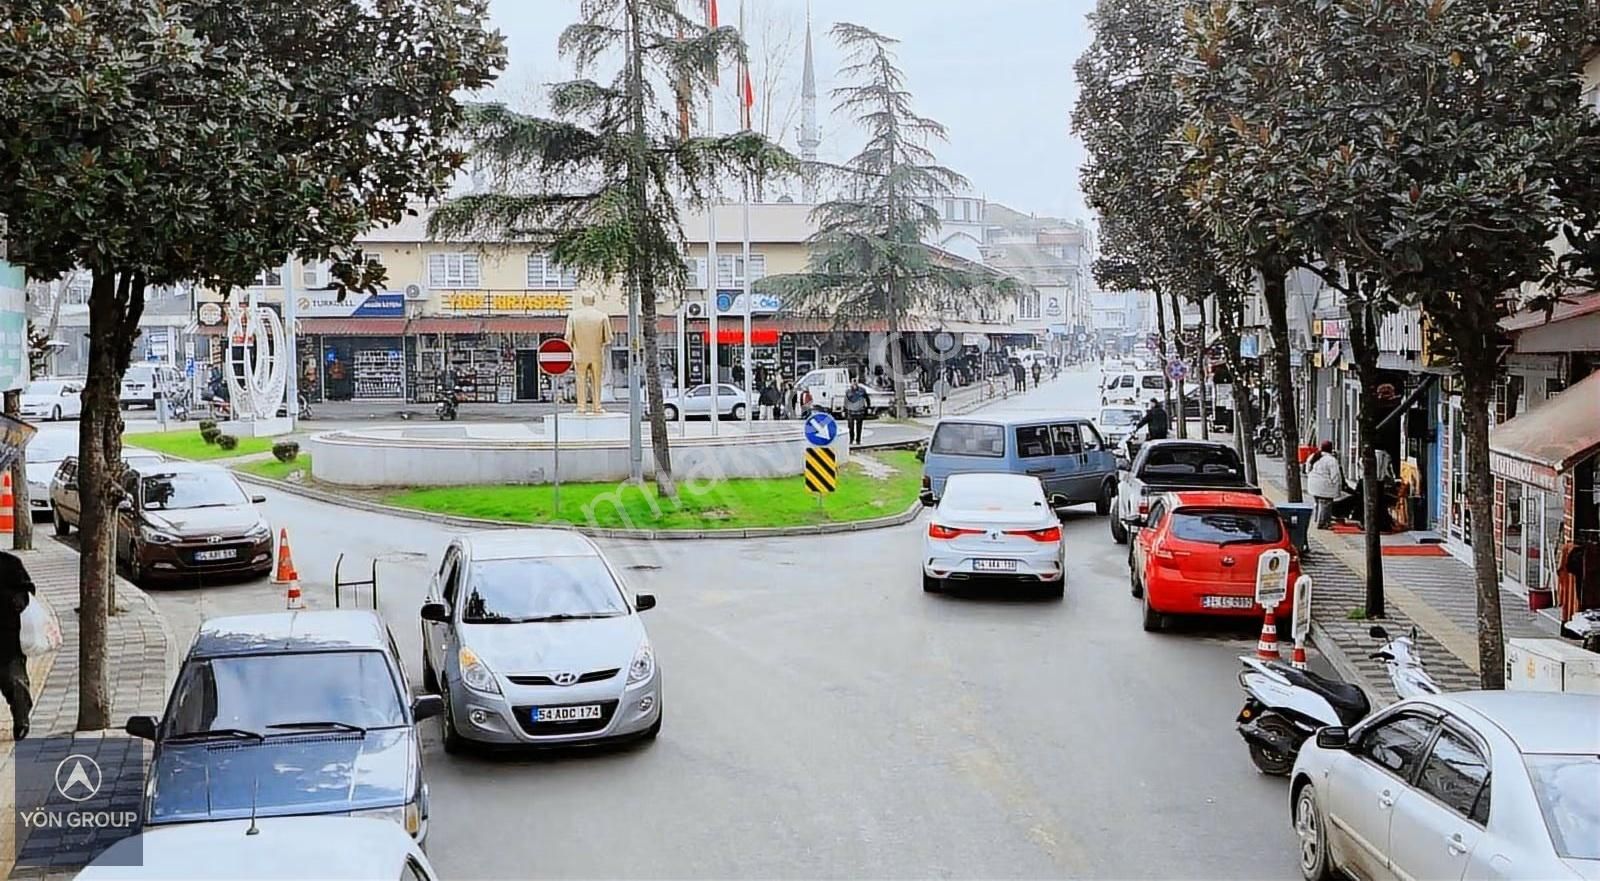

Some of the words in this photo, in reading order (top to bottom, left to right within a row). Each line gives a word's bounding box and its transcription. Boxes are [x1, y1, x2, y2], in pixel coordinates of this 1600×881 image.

[538, 709, 552, 720] 54
[555, 708, 576, 719] ADC
[580, 707, 599, 718] 174
